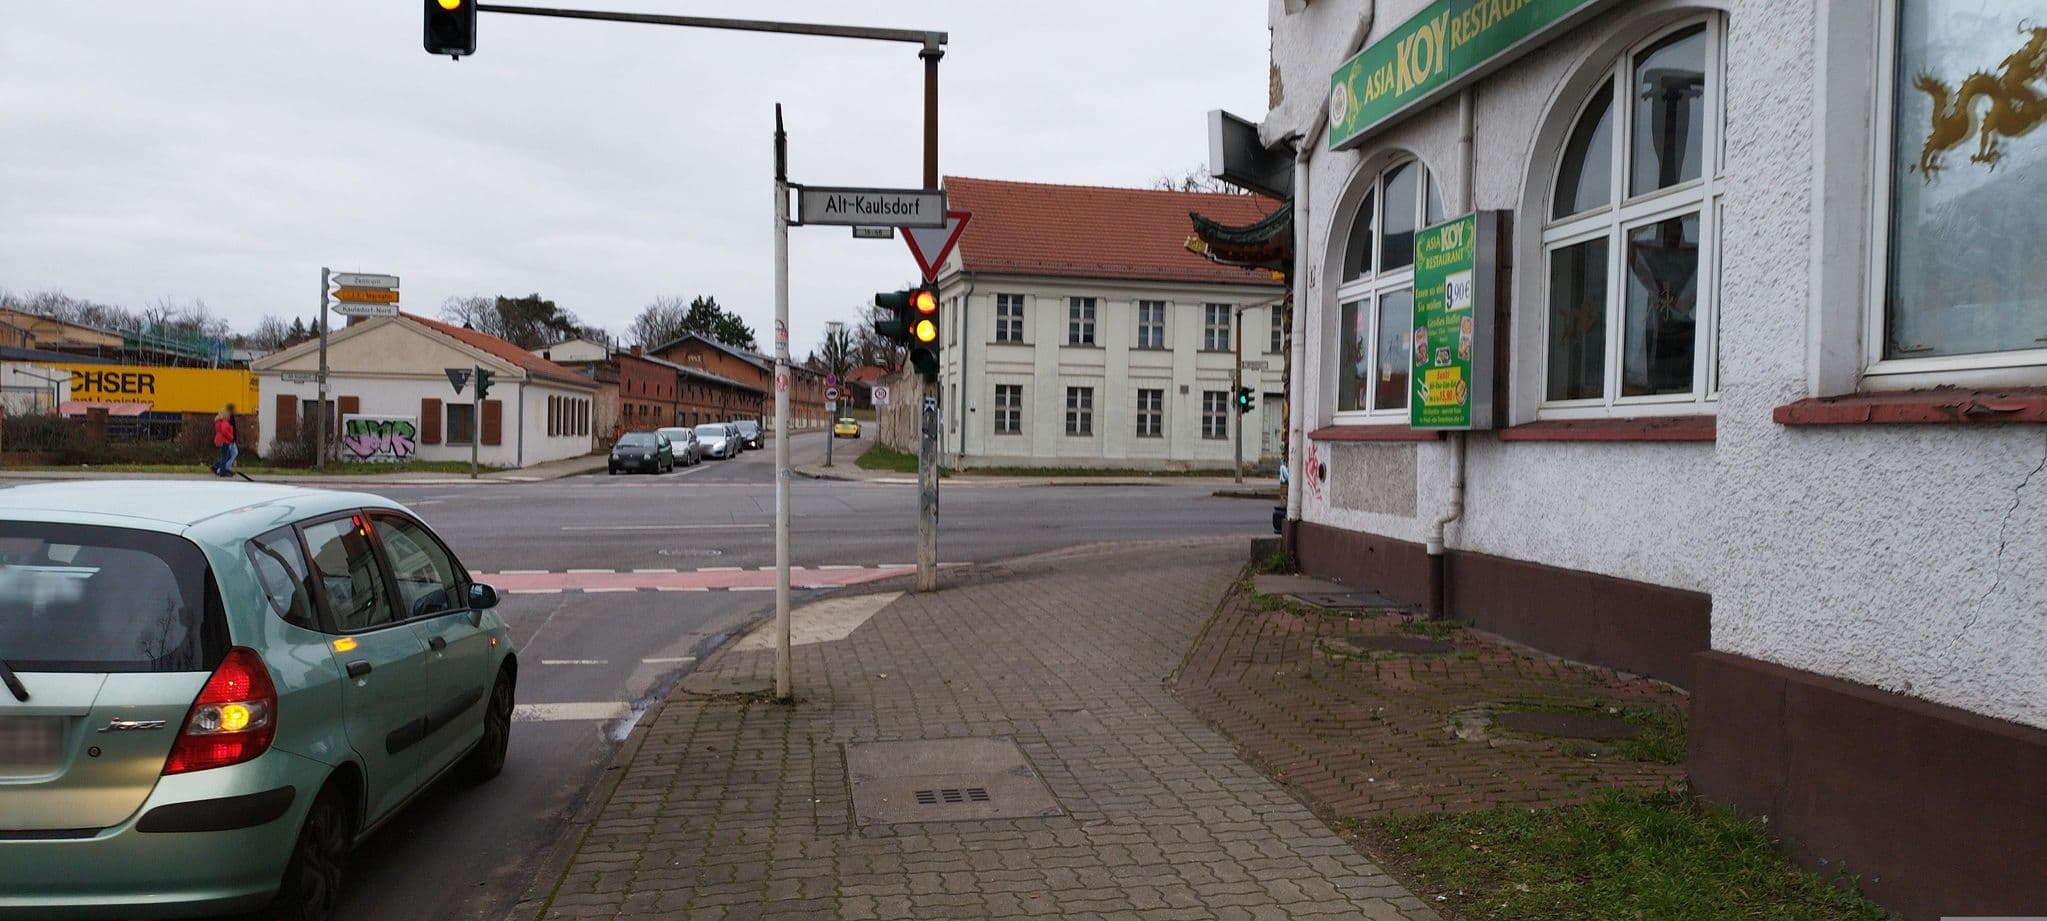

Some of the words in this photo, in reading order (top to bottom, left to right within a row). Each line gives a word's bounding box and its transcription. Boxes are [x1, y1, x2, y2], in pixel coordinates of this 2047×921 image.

[1364, 62, 1394, 104] ASIA
[1395, 9, 1450, 97] KOY
[1450, 0, 1531, 51] RESTAU
[825, 194, 920, 215] Alt-Kaulsdorf
[1426, 236, 1441, 251] ASIA
[1441, 220, 1465, 252] KOY
[1426, 248, 1463, 270] RESTAURANT
